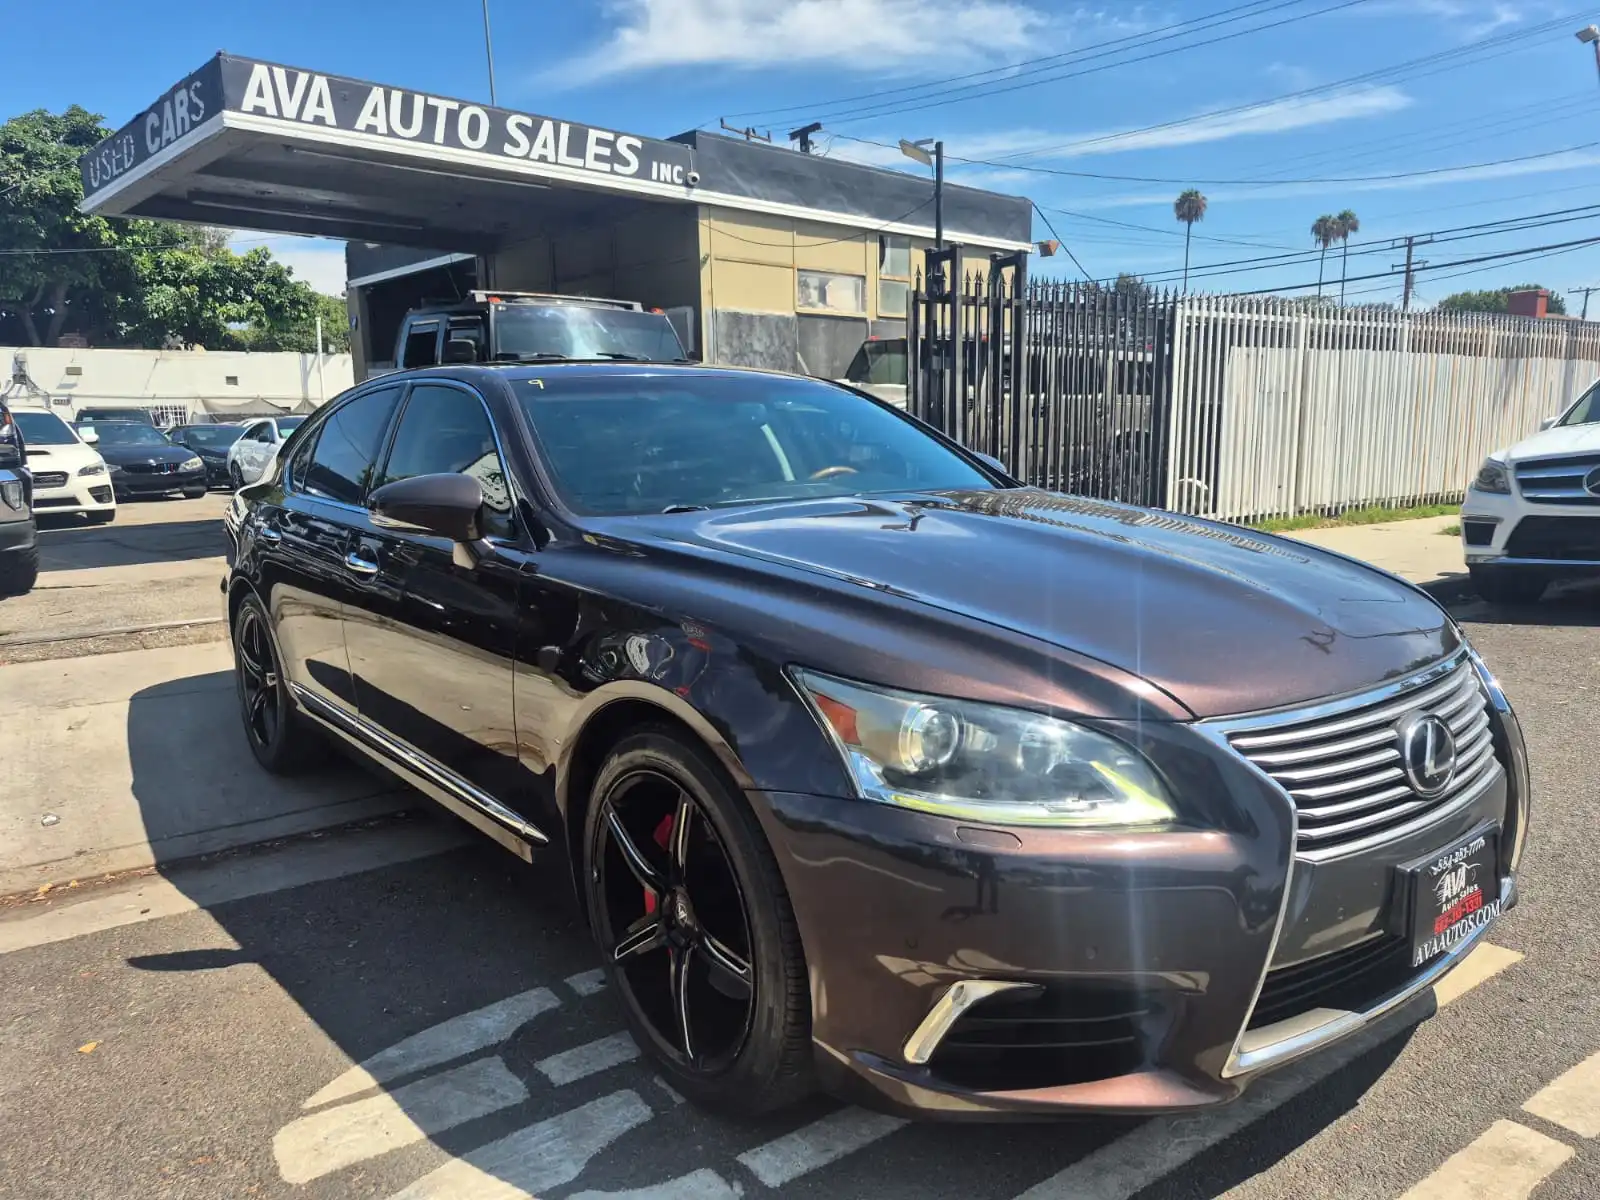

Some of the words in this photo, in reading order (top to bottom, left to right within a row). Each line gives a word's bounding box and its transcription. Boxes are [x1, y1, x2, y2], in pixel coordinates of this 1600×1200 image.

[89, 134, 135, 188] USED
[145, 81, 205, 154] CARS
[241, 64, 338, 126] AVA
[354, 87, 490, 150] AUTO
[503, 115, 643, 176] SALES
[651, 161, 684, 184] INC
[1441, 866, 1466, 903] AVA
[1414, 899, 1501, 968] AVAAUTOS.COM
